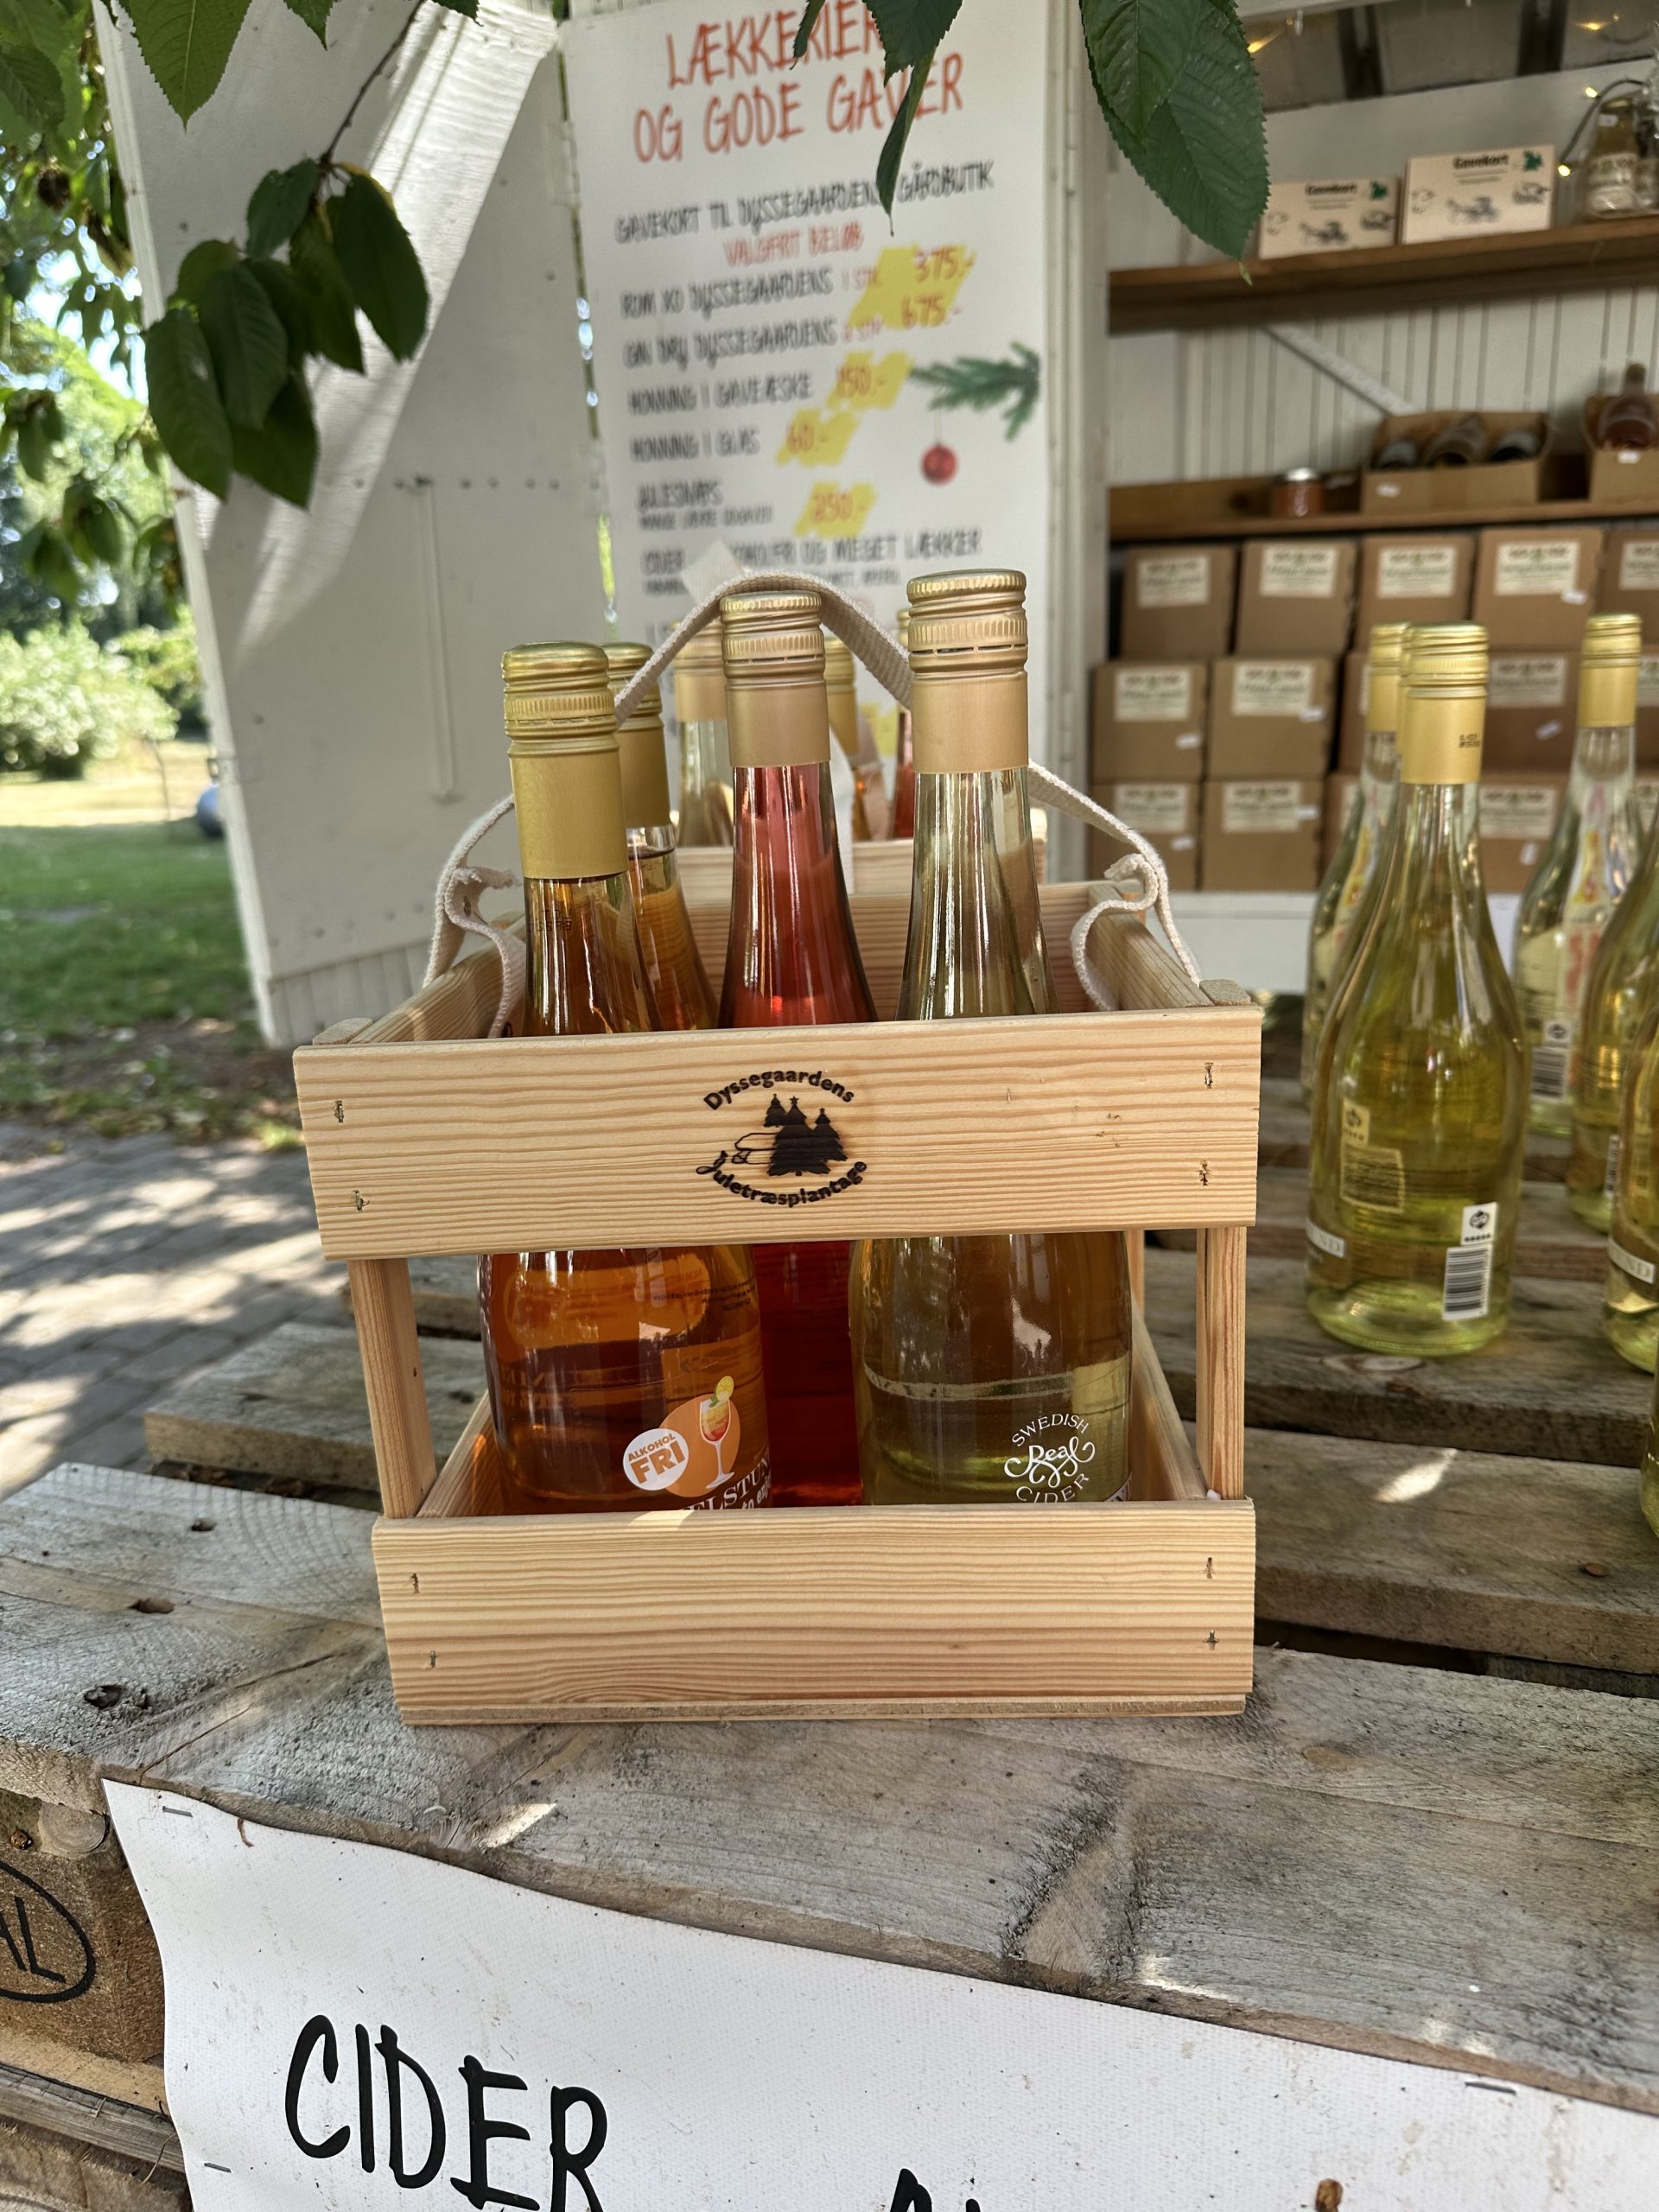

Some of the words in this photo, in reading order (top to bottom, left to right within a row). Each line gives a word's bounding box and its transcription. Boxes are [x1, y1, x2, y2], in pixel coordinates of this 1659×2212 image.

[633, 104, 683, 164] OG
[702, 82, 804, 156] GODE
[614, 204, 701, 244] GAVEKORT
[708, 200, 733, 230] TIL
[737, 178, 881, 235] DYSSEGAARDEN
[702, 1070, 855, 1111] Dyssegaardens
[695, 1149, 868, 1209] Juletræsplantage
[627, 1432, 677, 1462] ALKOHOL
[1011, 1413, 1090, 1447] SWEDISH
[630, 1440, 686, 1484] FRI
[1003, 1435, 1096, 1488] Real
[1015, 1472, 1090, 1503] CIDER
[285, 2014, 607, 2212] CIDER
